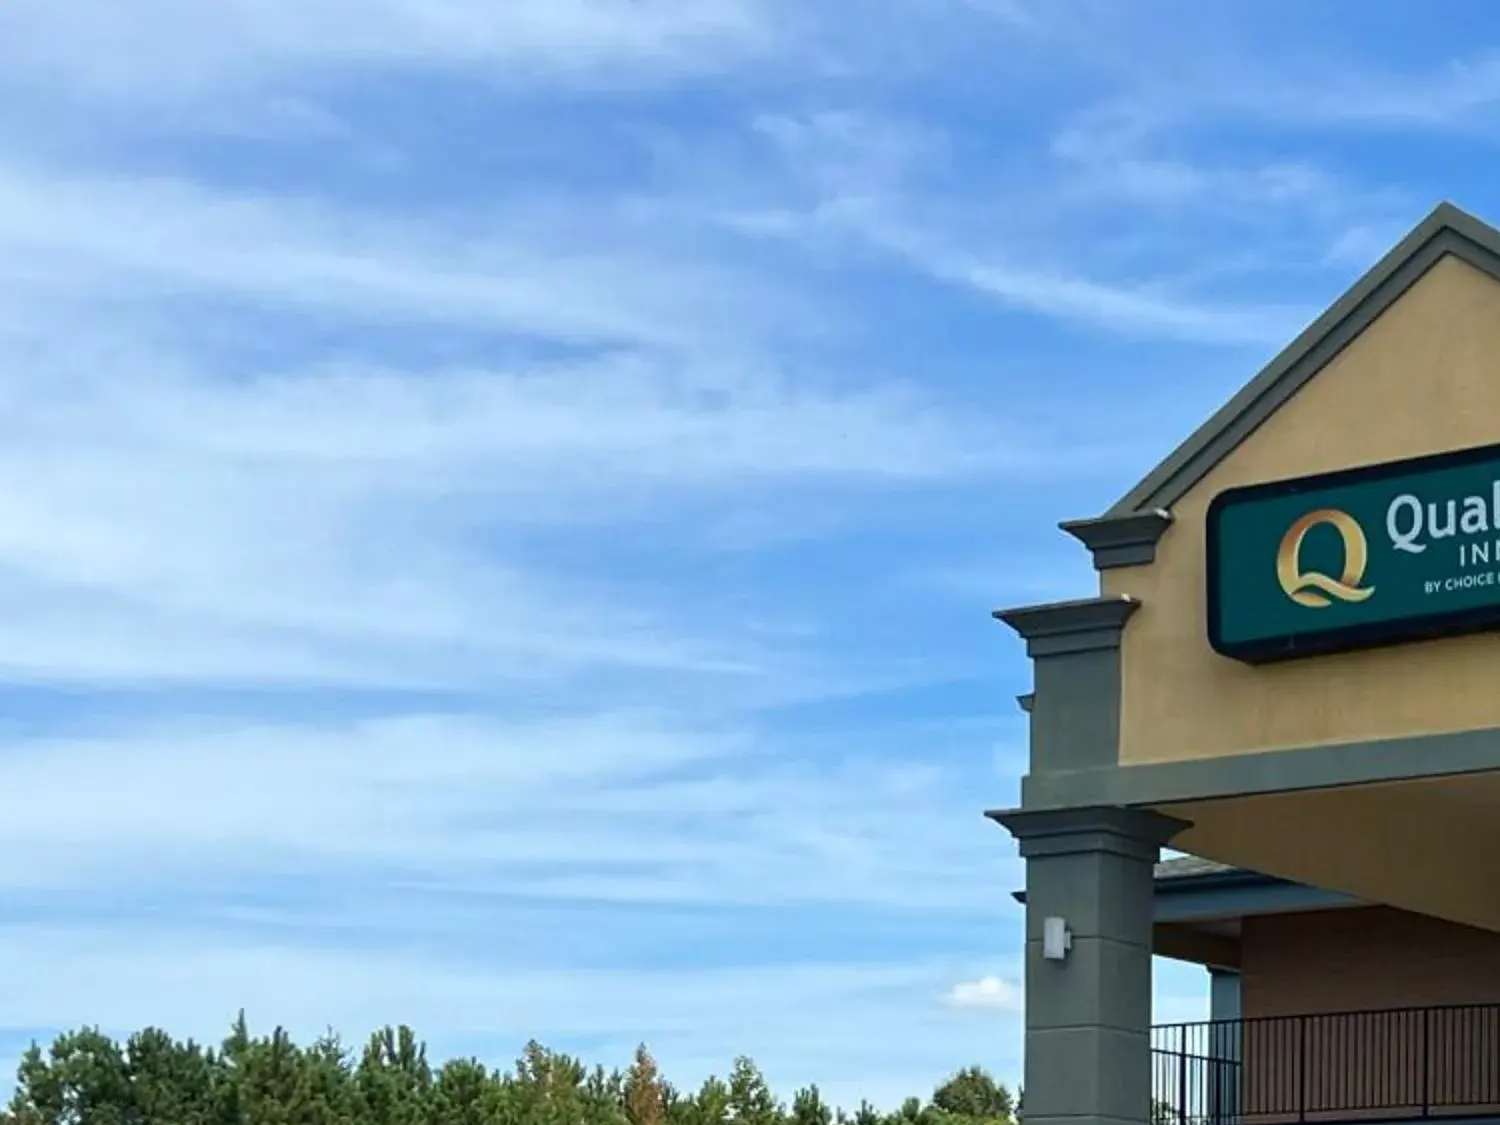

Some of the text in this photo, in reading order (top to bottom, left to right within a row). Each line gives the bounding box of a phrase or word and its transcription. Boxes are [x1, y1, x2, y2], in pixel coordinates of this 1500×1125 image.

[1276, 508, 1376, 607] Q
[1424, 580, 1441, 594] BY
[1444, 571, 1494, 591] CHOICE
